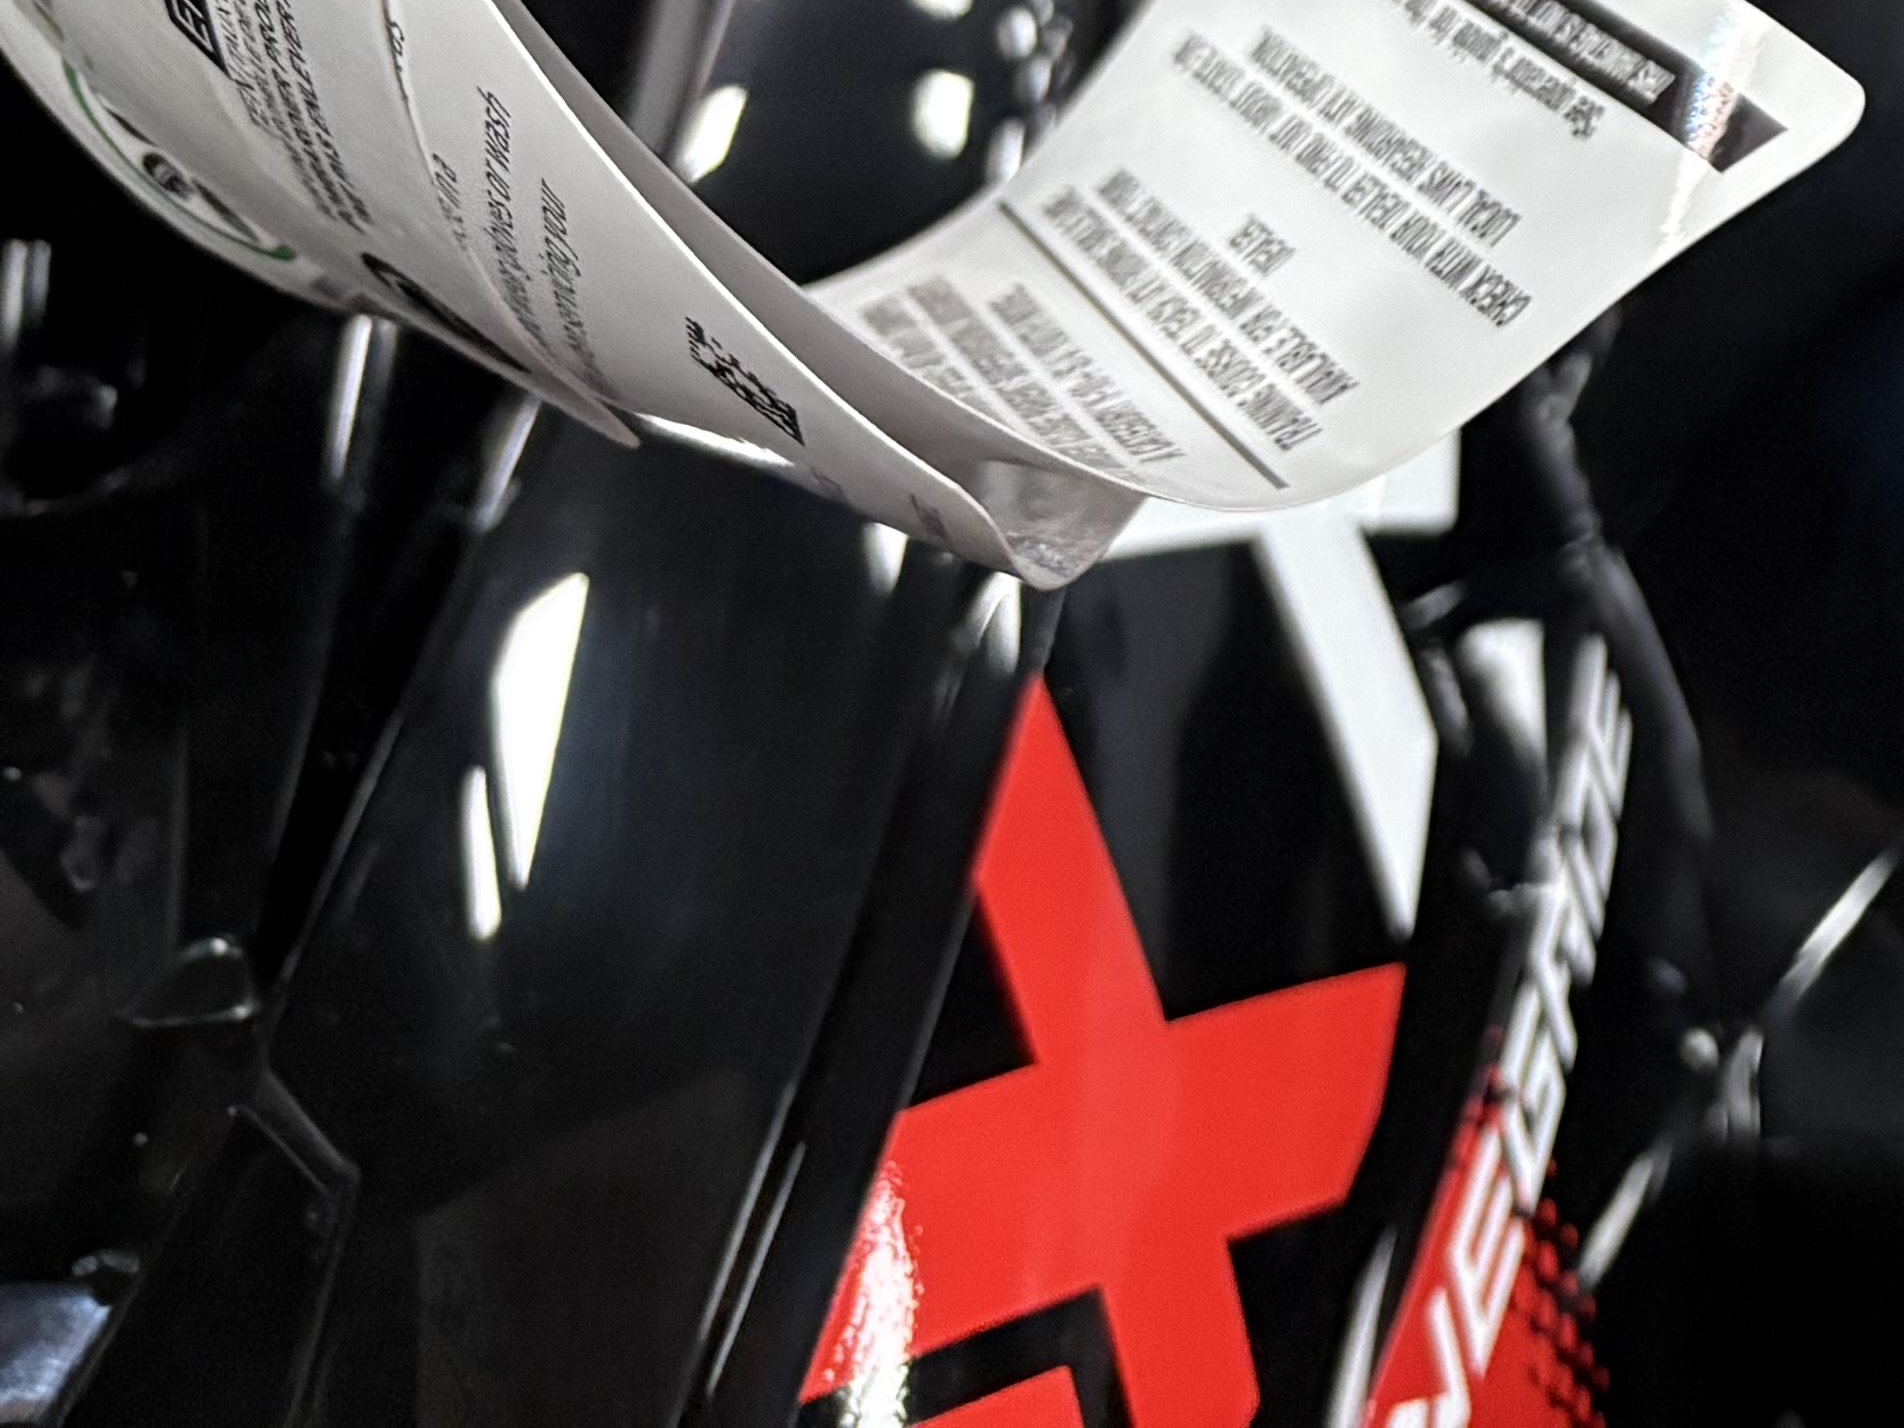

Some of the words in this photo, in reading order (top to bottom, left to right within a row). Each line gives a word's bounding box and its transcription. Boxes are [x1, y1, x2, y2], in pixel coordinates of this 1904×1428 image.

[476, 86, 511, 173] wash
[1342, 103, 1437, 184] REGARDING
[485, 158, 511, 203] or
[1320, 151, 1361, 195] TO
[1339, 168, 1410, 234] DEALER
[1416, 159, 1476, 215] LAWS
[541, 177, 579, 261] your
[1387, 206, 1446, 263] YOUR
[1454, 187, 1520, 246] LOCAL
[1423, 234, 1482, 292] WITH
[1459, 262, 1531, 330] CHECK
